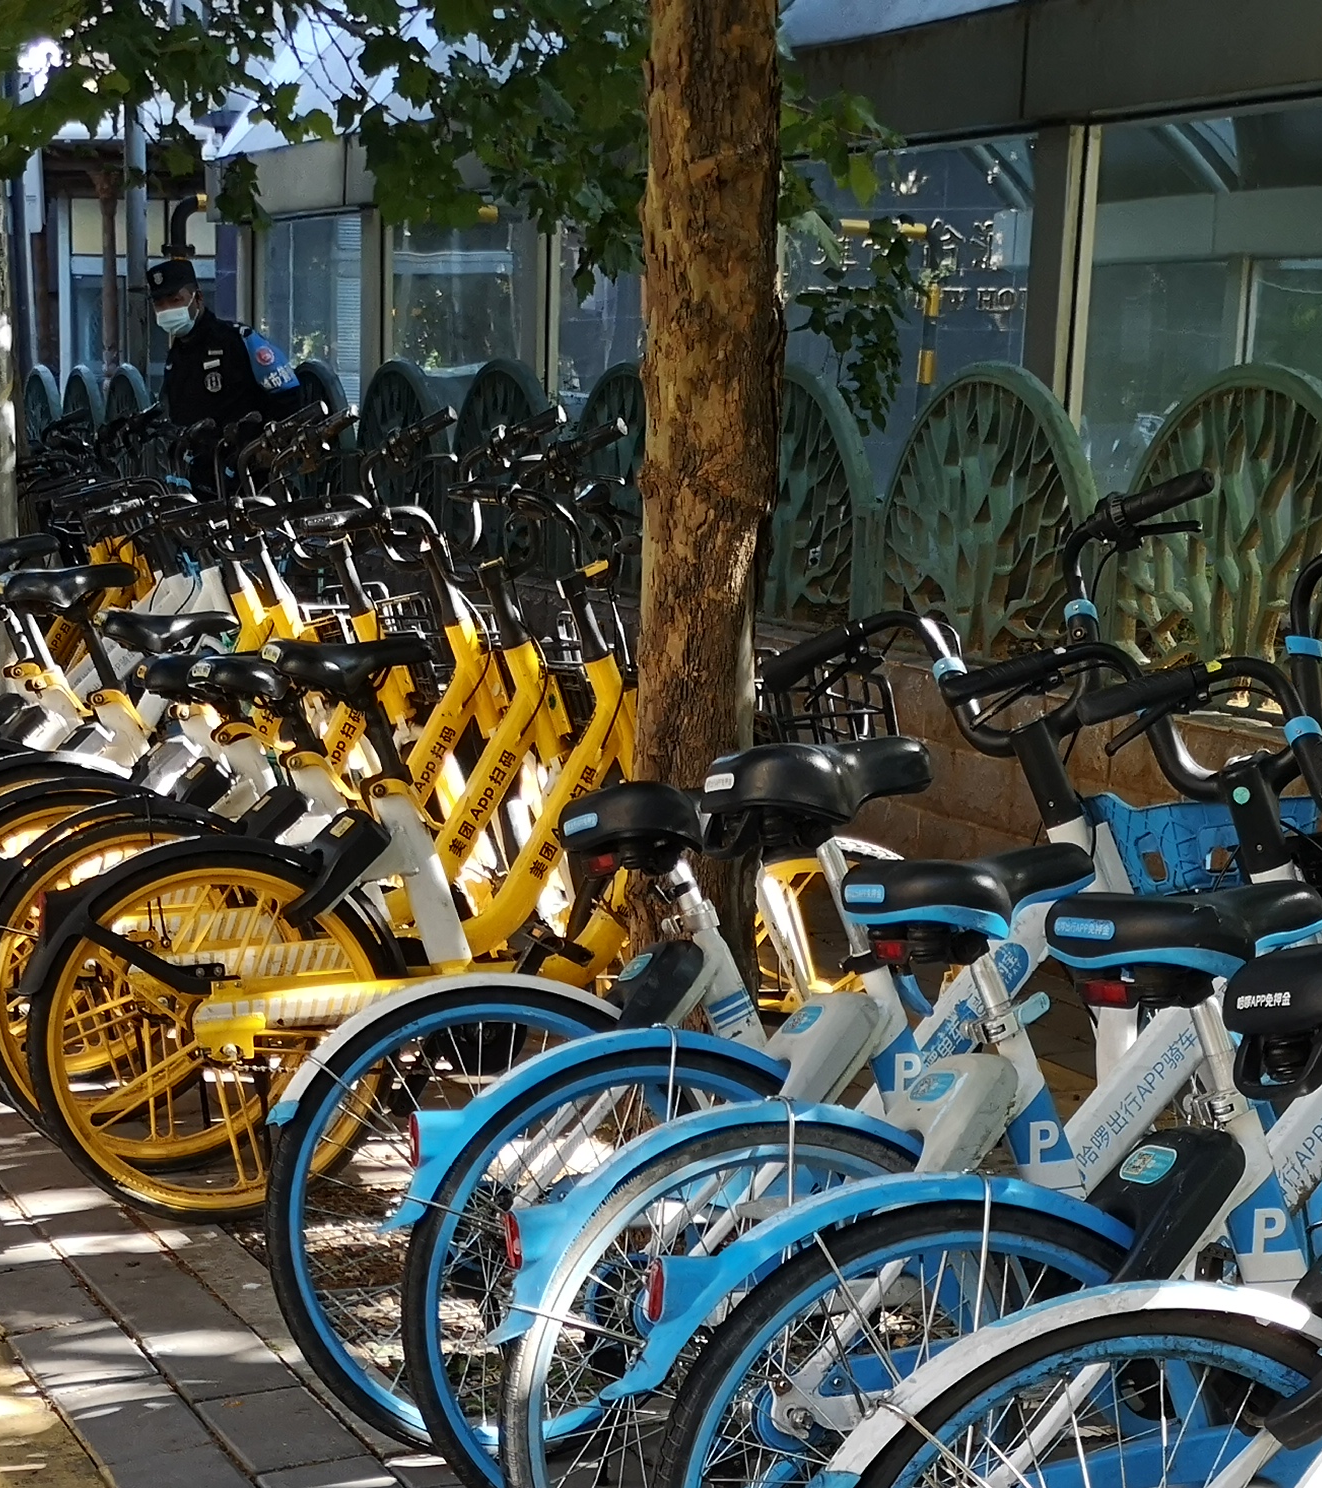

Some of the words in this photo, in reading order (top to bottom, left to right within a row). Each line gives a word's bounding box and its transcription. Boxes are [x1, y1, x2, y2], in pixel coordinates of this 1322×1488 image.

[1076, 1028, 1199, 1168] 哈啰出行APP骑车
